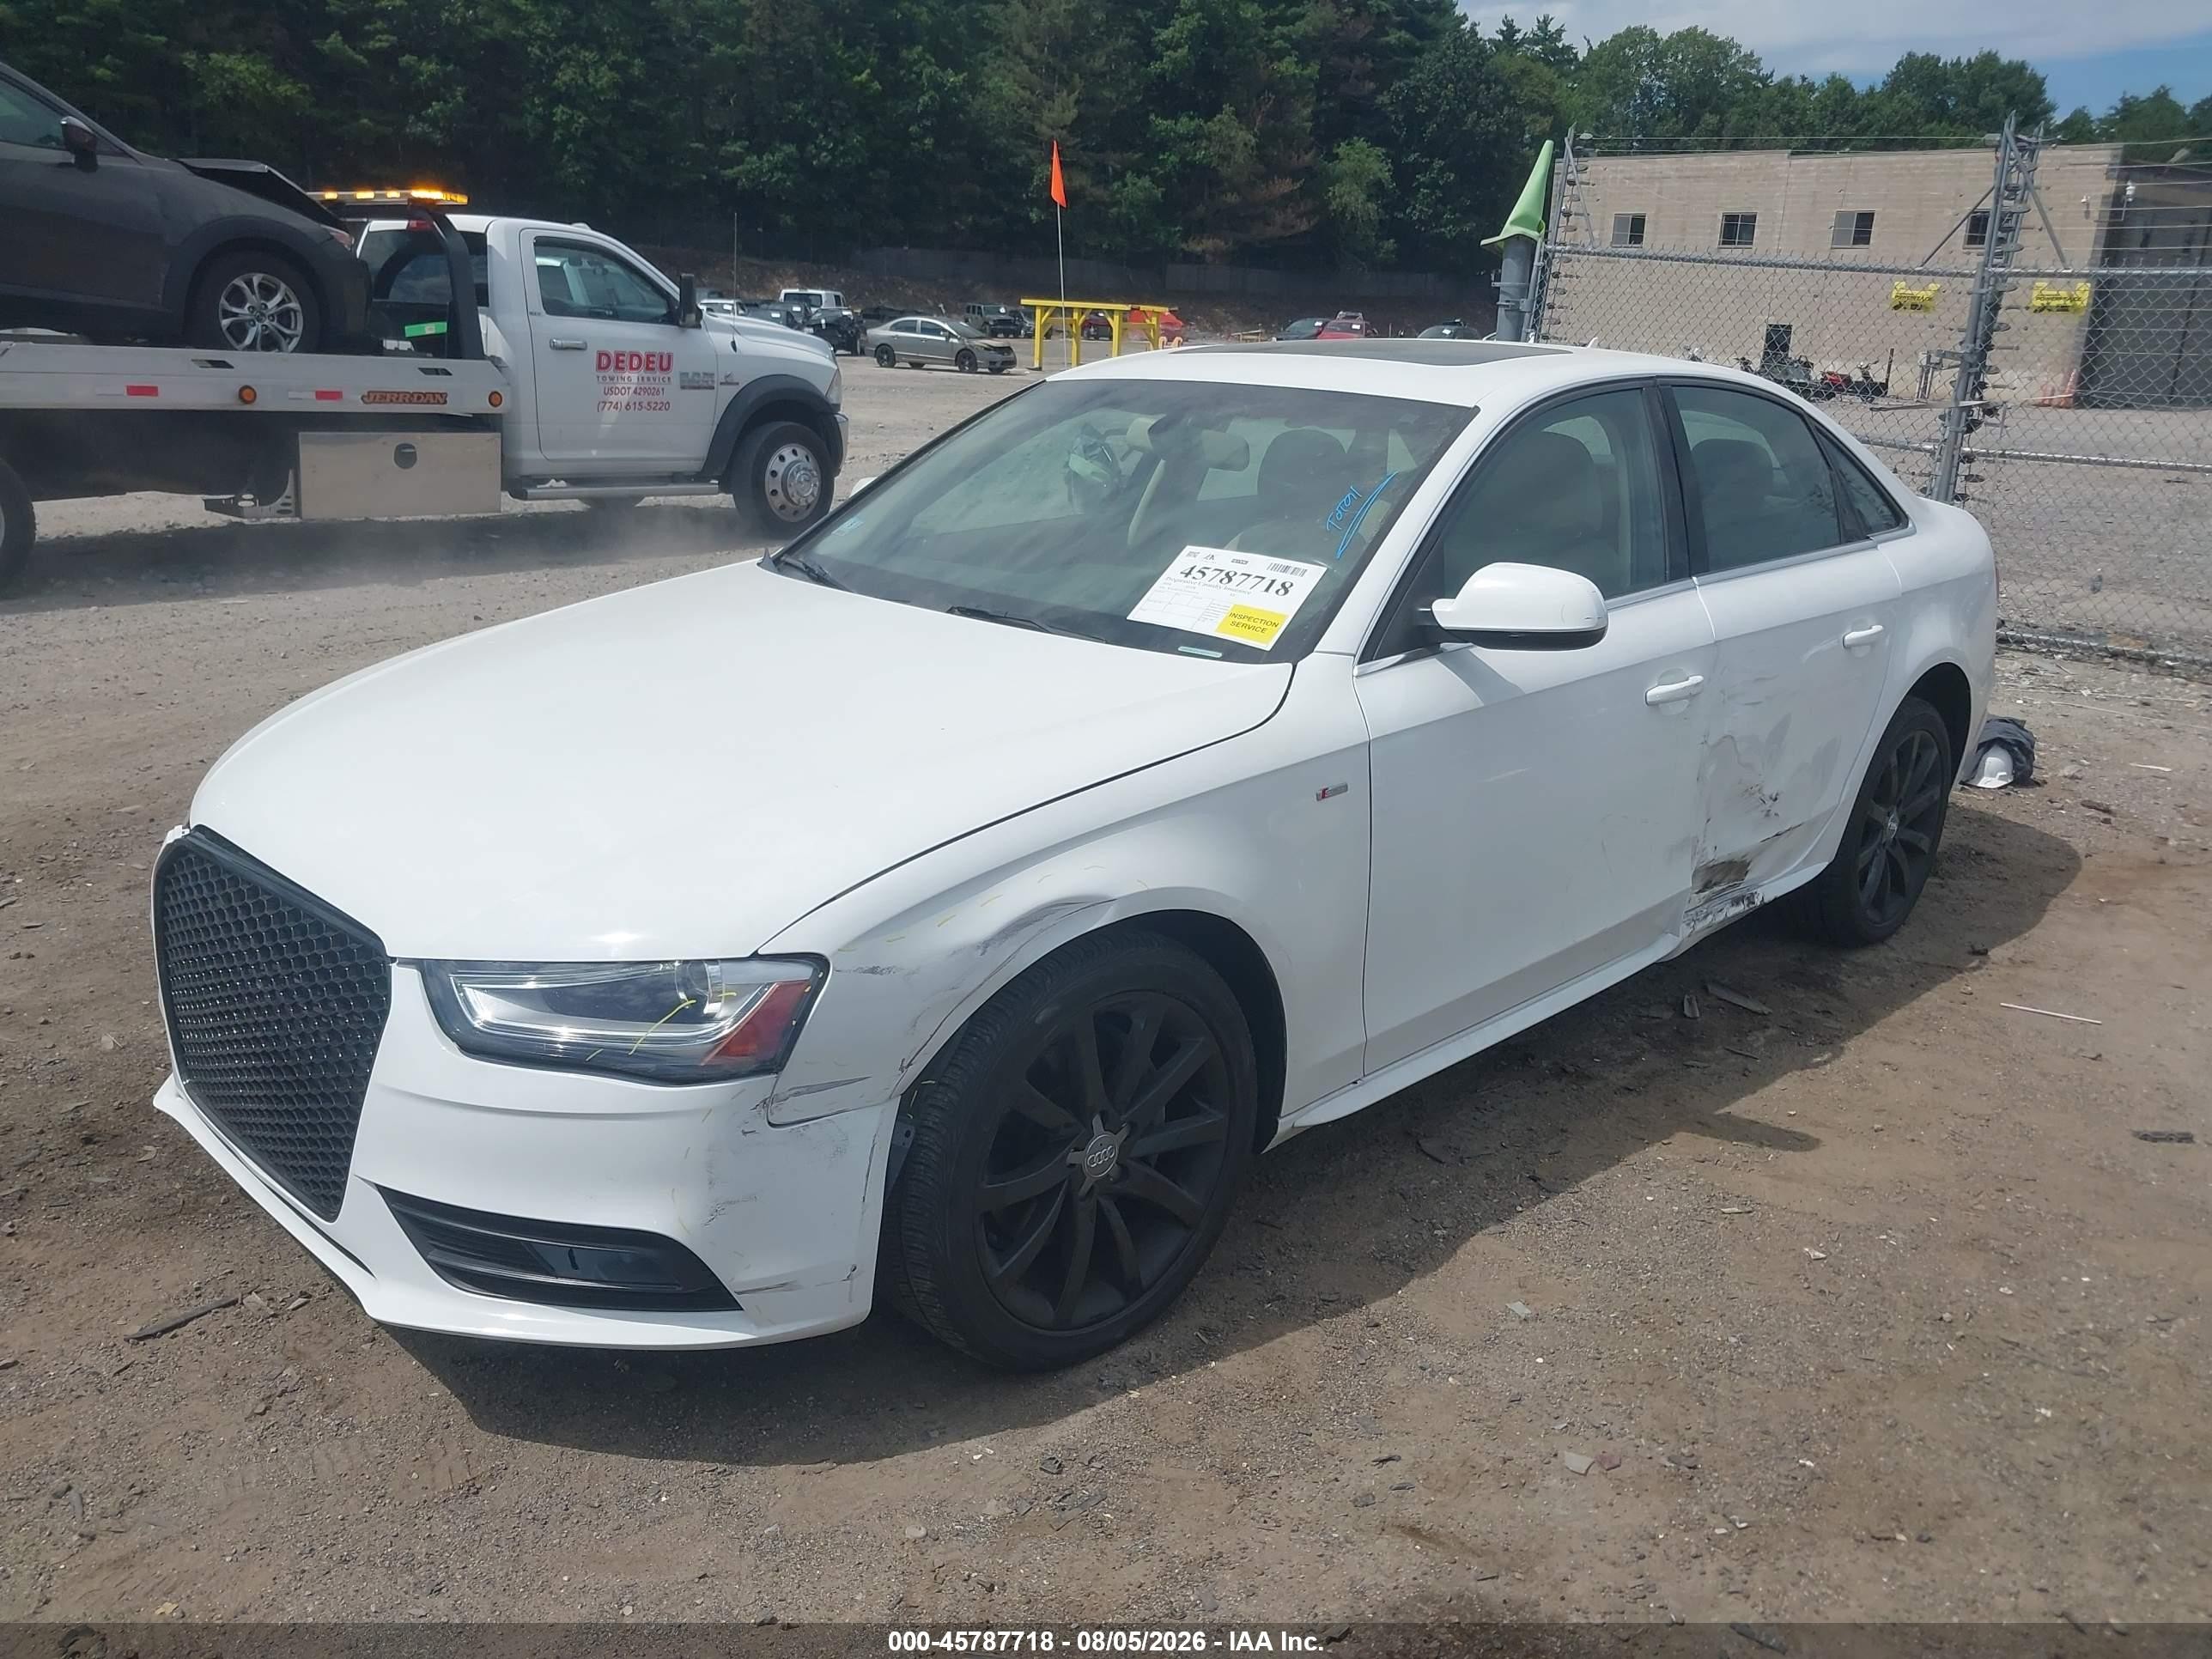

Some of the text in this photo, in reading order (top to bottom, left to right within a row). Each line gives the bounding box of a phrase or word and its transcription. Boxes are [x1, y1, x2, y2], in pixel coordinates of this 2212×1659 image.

[596, 350, 673, 374] DEDEU
[604, 386, 665, 396] USDOT 4290261
[597, 401, 671, 412] (774) 615-5220
[1180, 565, 1294, 597] 45787718
[1229, 611, 1279, 628] INSPECTION
[1230, 621, 1268, 634] SERVICE
